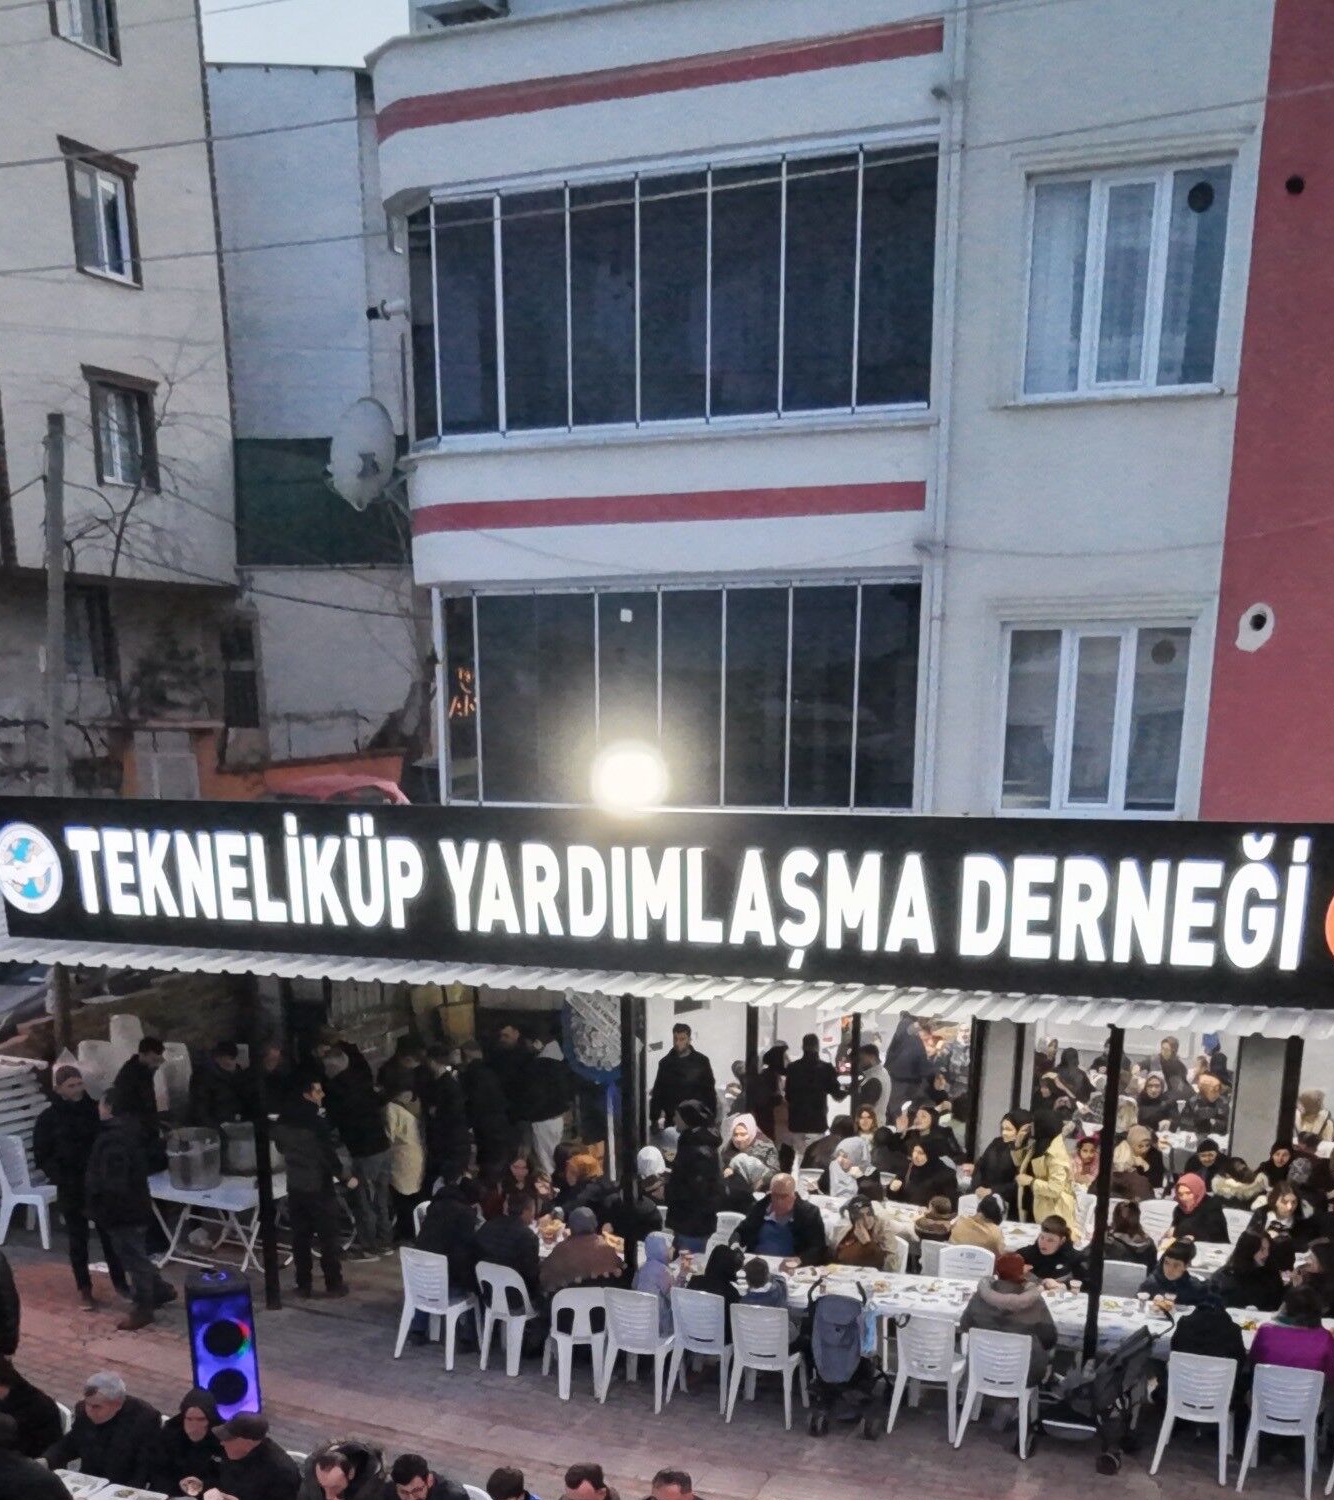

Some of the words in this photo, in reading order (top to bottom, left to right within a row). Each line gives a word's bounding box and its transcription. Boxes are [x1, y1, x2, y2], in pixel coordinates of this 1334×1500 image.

[66, 814, 424, 929] TEKNELİKÜP
[439, 841, 935, 970] YARDIMLAŞMA
[959, 835, 1309, 970] DERNEĞİ
